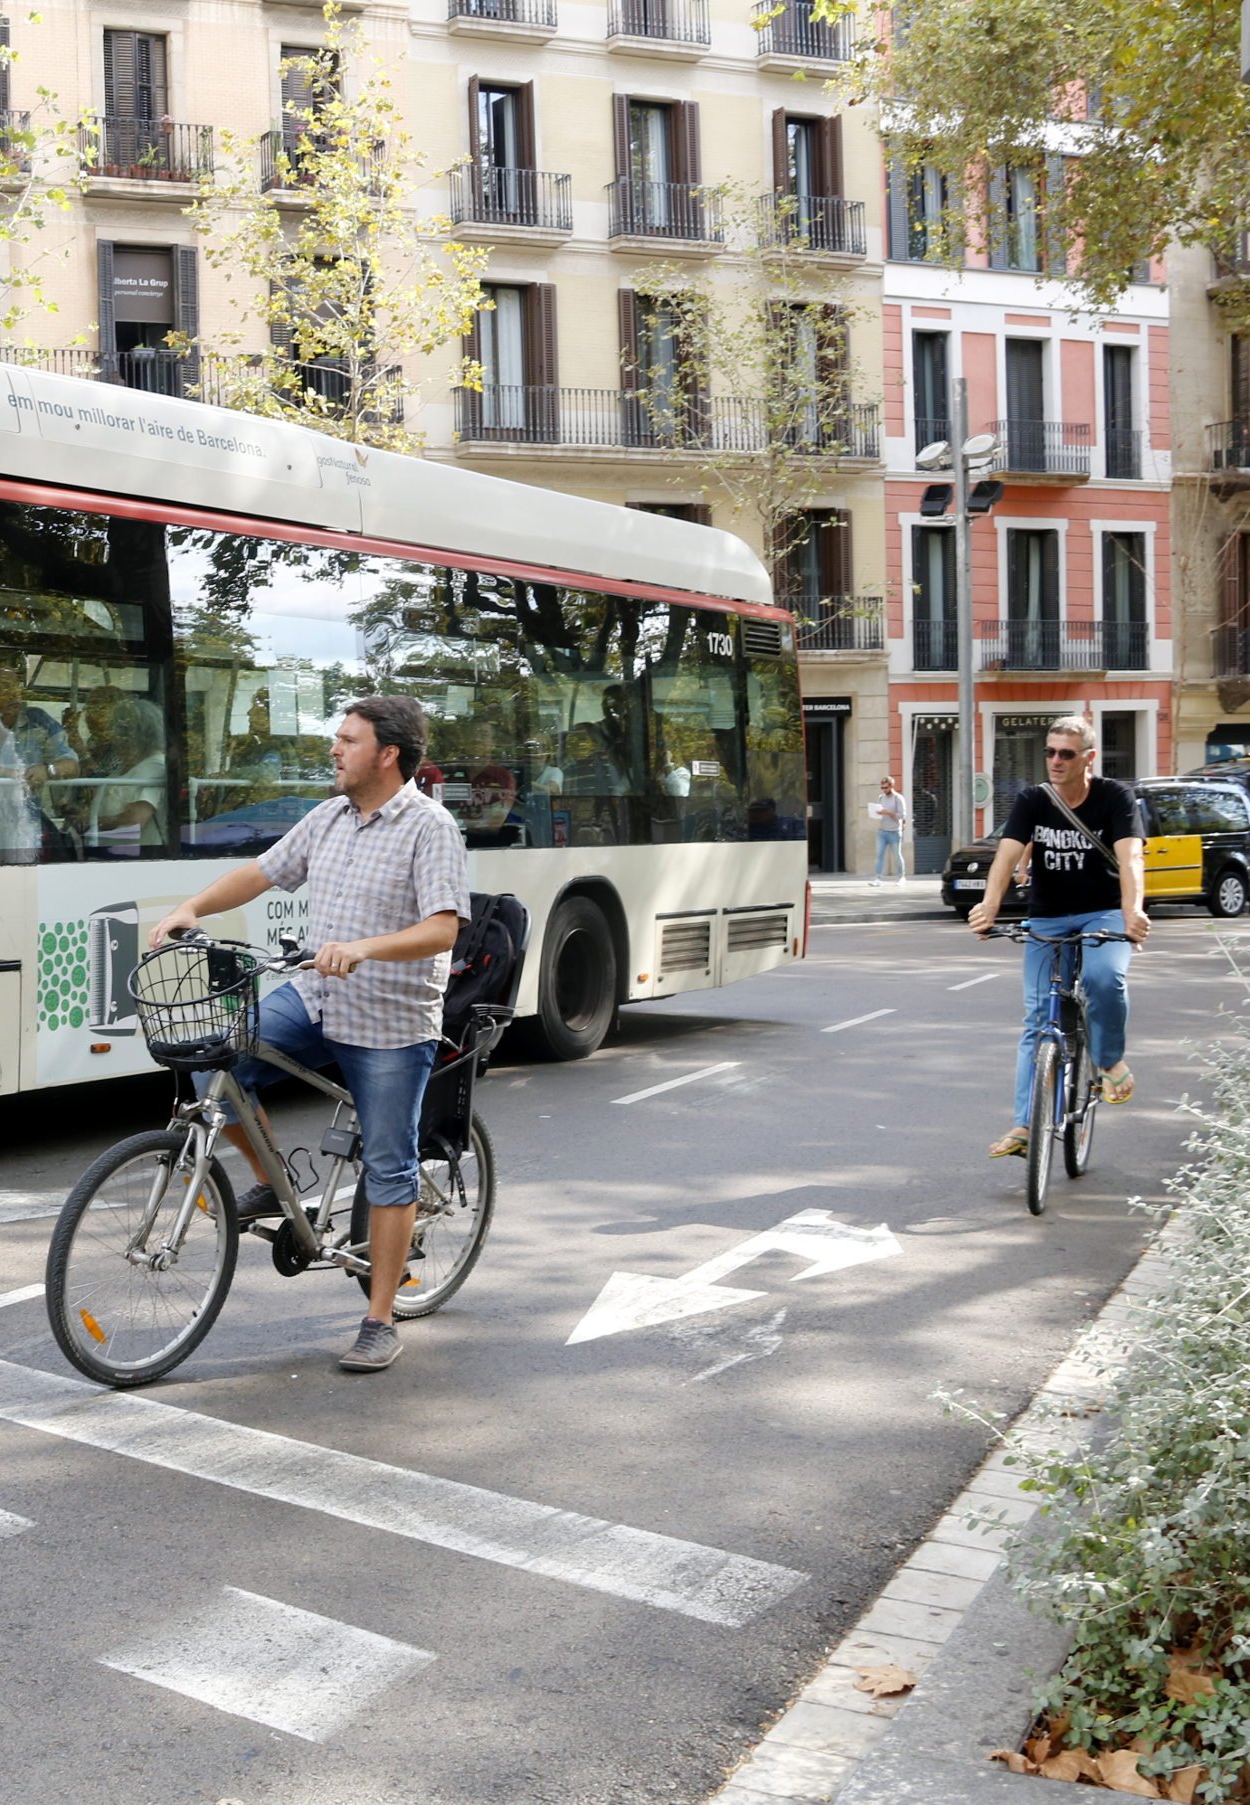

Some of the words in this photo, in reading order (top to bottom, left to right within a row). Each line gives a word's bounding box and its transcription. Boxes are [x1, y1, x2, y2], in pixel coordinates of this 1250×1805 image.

[138, 278, 149, 287] La
[150, 279, 168, 289] Grup
[7, 393, 34, 411] em
[38, 400, 74, 420] mou
[78, 407, 136, 432] millorar
[139, 416, 174, 439] l'aire
[177, 426, 195, 444] de
[707, 631, 733, 657] 1730
[1044, 850, 1085, 870] CITY
[266, 900, 293, 919] COM
